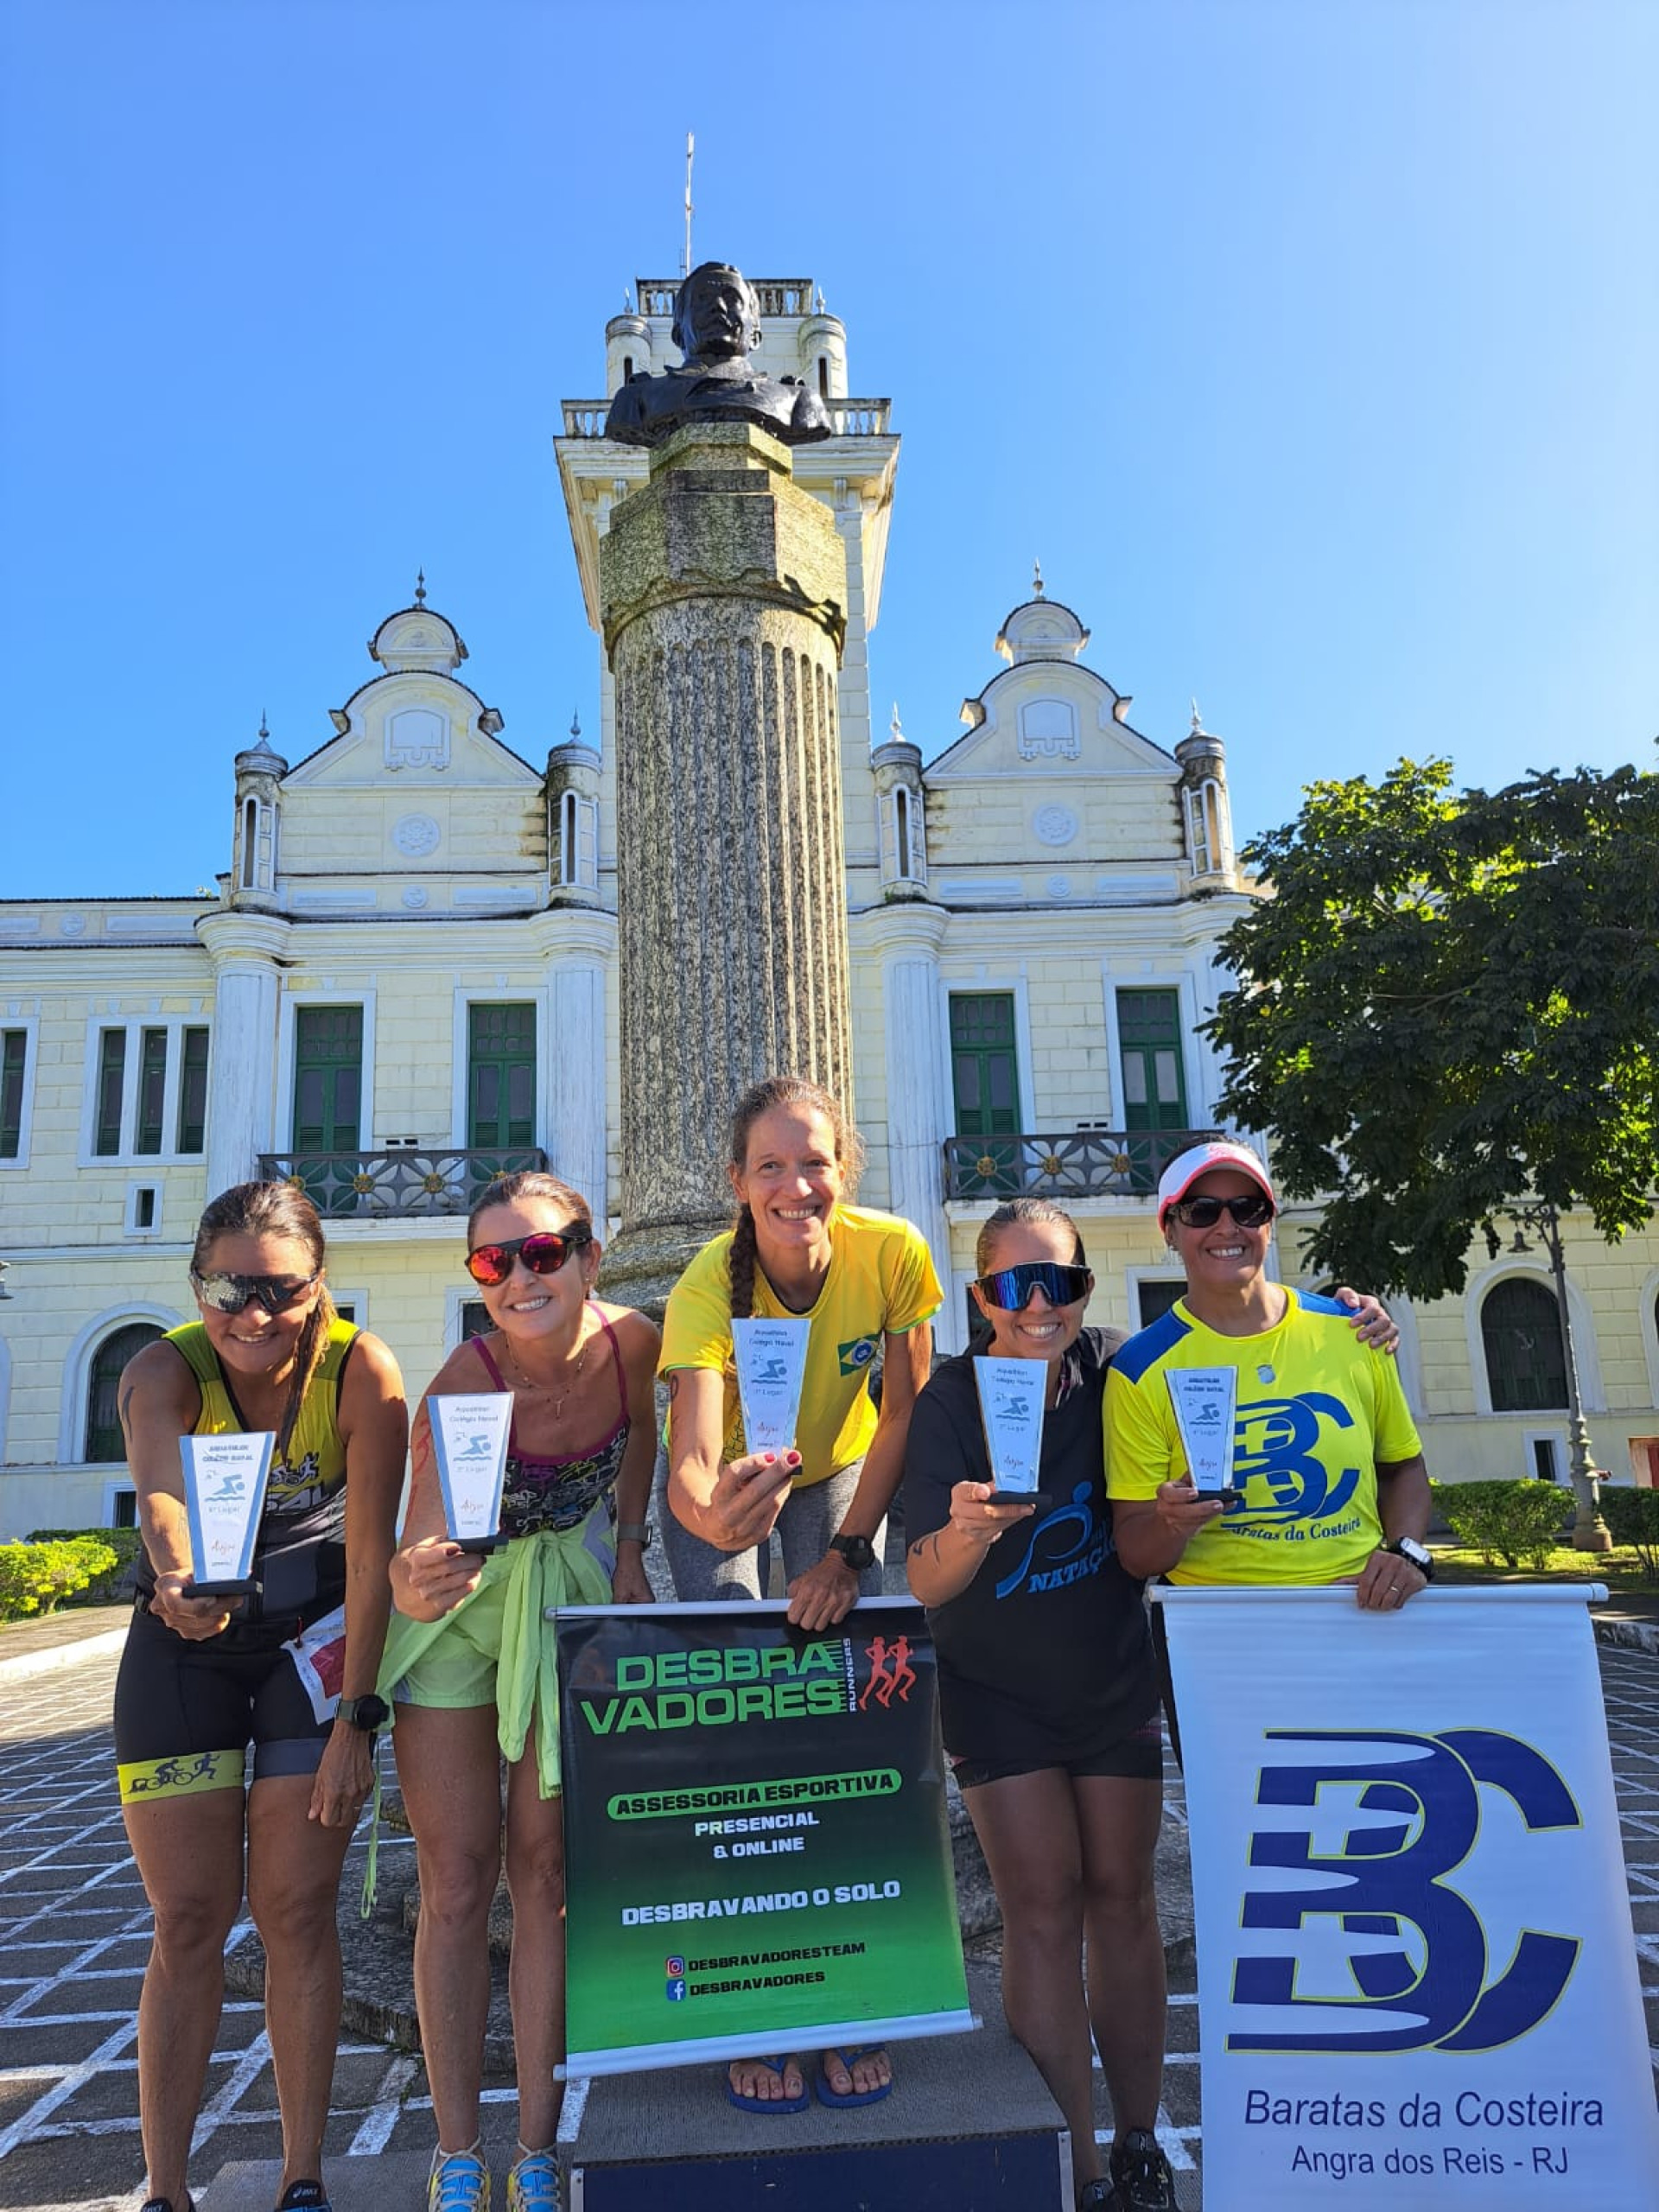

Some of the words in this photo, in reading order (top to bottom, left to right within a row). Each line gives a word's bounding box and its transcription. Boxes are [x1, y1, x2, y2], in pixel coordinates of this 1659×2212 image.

[1286, 1524, 1305, 1541] da
[617, 1639, 843, 1692] DESBRA
[842, 1637, 858, 1713] RUNNERS
[581, 1679, 848, 1735] VADORES
[615, 1787, 760, 1815] ASSESSORIA
[765, 1774, 893, 1801] ESPORTIVA
[694, 1810, 820, 1837] PRESENCIAL
[713, 1846, 728, 1859] &
[732, 1837, 805, 1859] ONLINE
[621, 1891, 808, 1926] DESBRAVANDO
[813, 1888, 831, 1907] O
[835, 1880, 901, 1904] SOLO
[688, 1942, 865, 1972] DESBRAVADORESTEAM
[690, 1971, 825, 1997] DESBRAVADORES
[1244, 2089, 1386, 2127] Baratas
[1398, 2092, 1442, 2127] da
[1455, 2091, 1605, 2127] Costeira
[1292, 2145, 1375, 2180] Angra
[1383, 2148, 1434, 2175] dos
[1444, 2147, 1505, 2175] Reis
[1532, 2147, 1570, 2175] RJ
